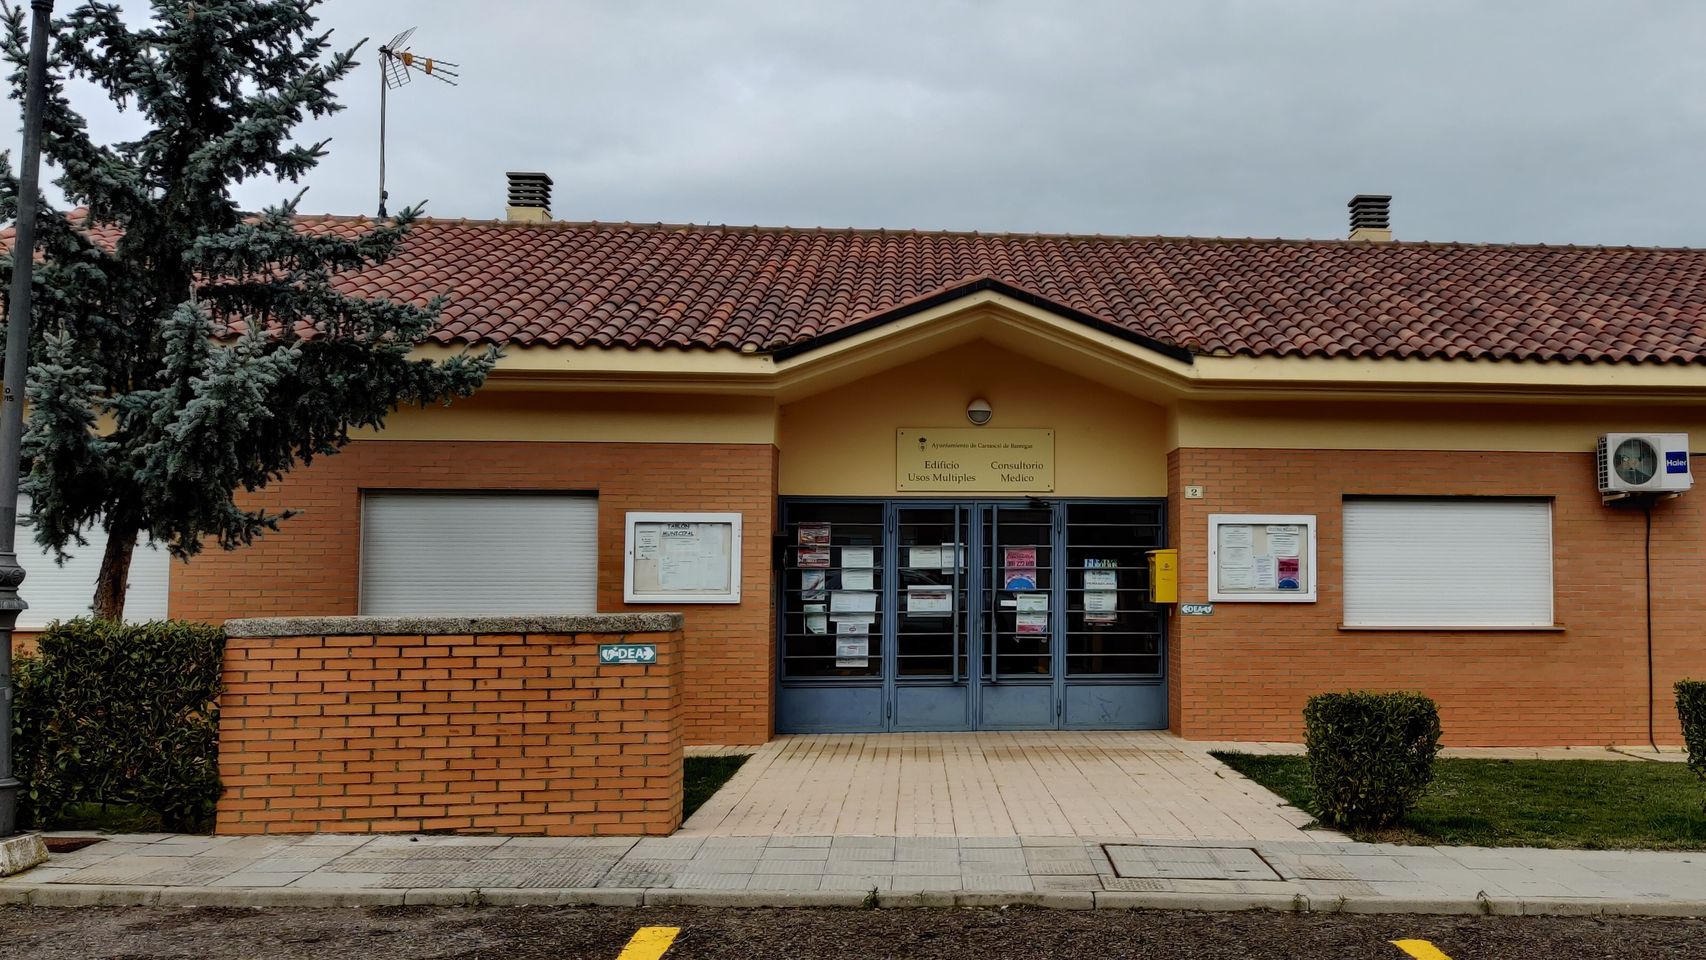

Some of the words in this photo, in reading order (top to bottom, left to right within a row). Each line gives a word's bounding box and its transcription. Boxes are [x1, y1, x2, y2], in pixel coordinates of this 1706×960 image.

[931, 442, 970, 450] Ayuntamiento
[924, 460, 960, 470] Edificio
[990, 460, 1044, 470] Consultorio
[1666, 459, 1687, 467] Haier
[908, 473, 930, 482] Usos
[932, 473, 977, 484] Multiples
[1000, 473, 1035, 482] Medico
[1191, 488, 1198, 497] 2
[618, 648, 644, 659] DEA
